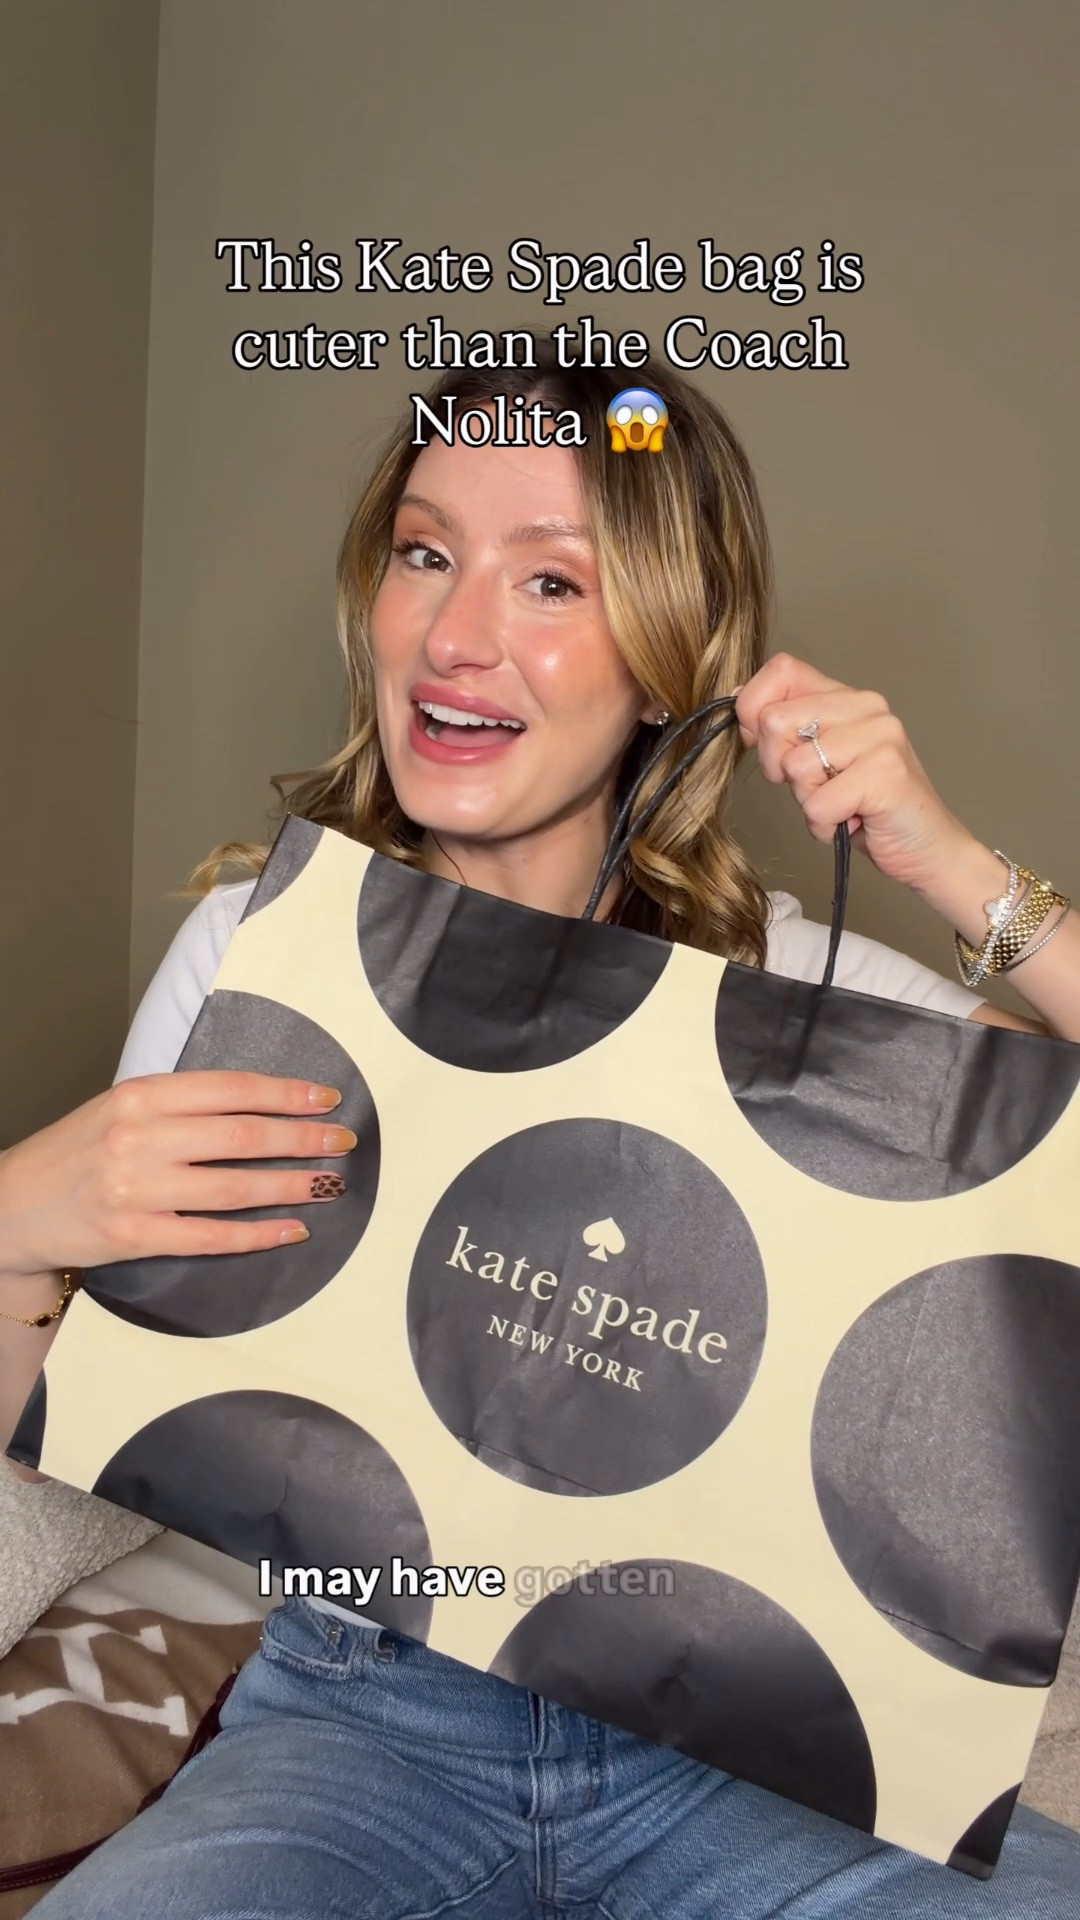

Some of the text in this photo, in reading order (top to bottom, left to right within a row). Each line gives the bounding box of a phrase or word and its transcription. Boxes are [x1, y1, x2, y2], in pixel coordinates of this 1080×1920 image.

[445, 1225, 729, 1365] kate spade
[485, 1314, 645, 1392] NEW YORK
